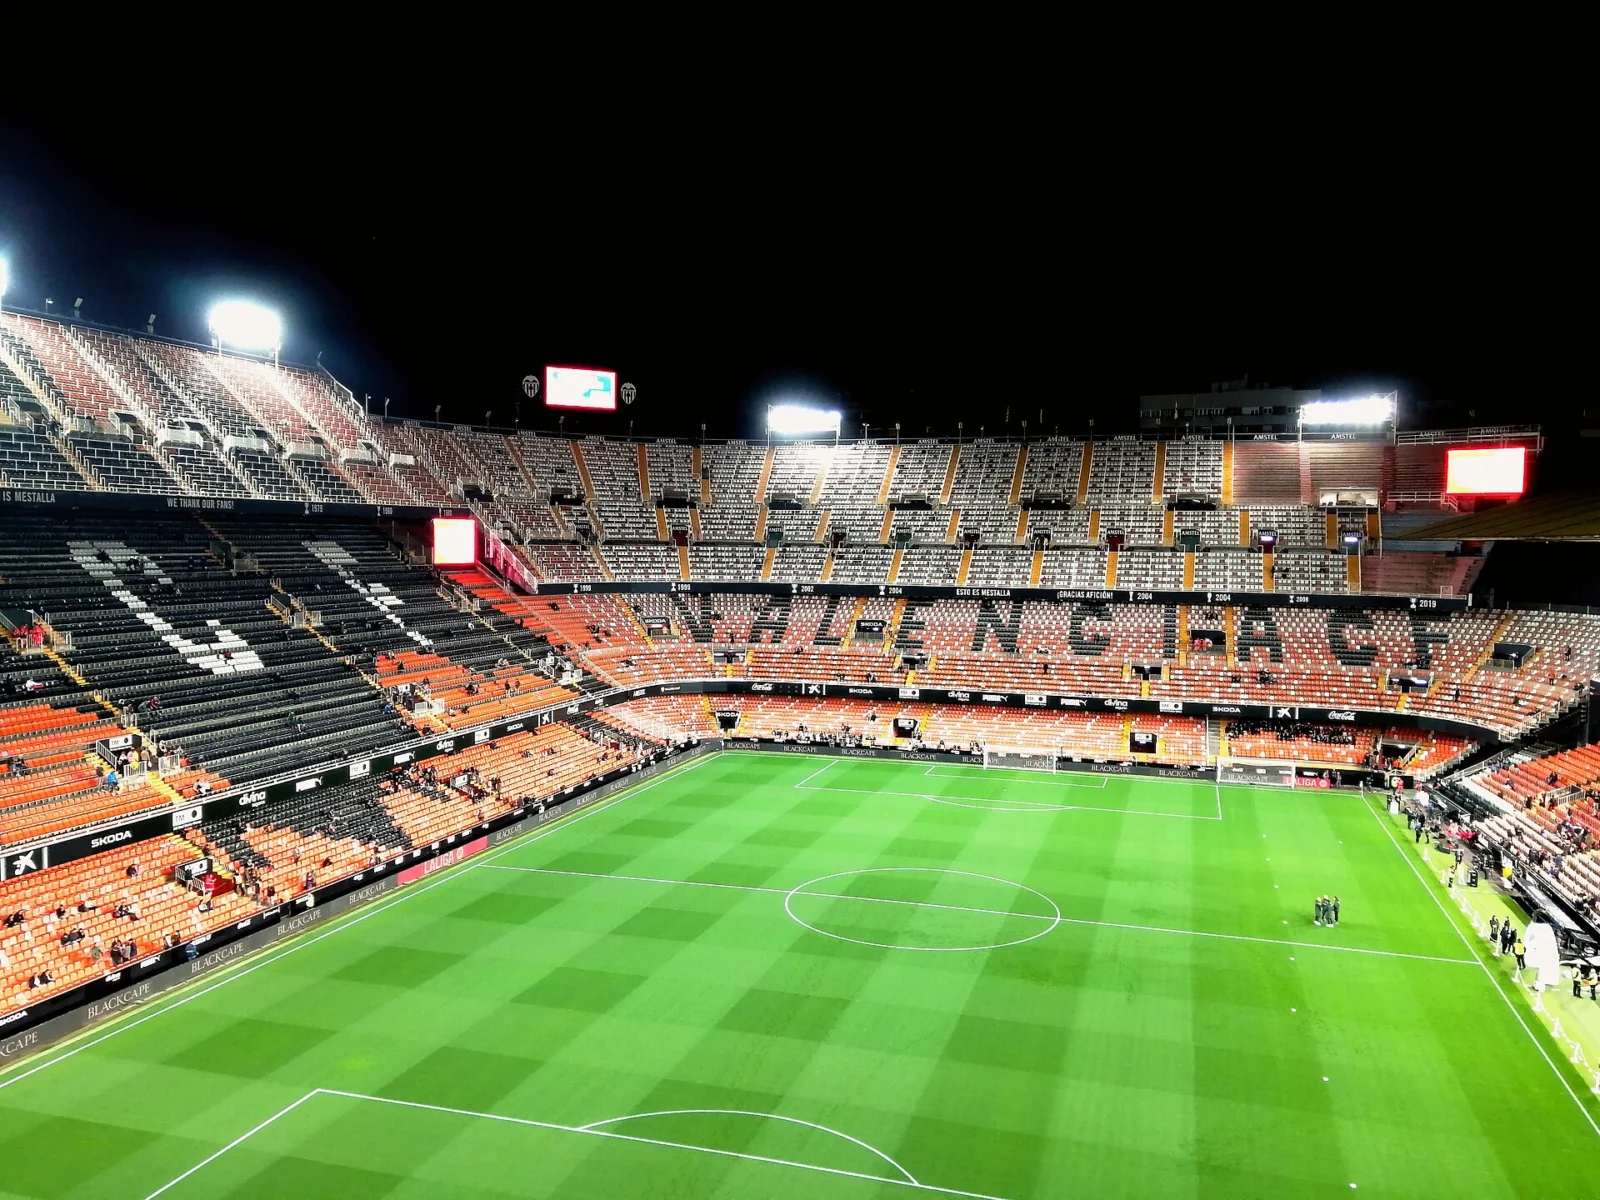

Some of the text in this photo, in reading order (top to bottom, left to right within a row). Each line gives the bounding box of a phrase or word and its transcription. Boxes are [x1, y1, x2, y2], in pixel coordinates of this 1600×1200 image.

[2, 491, 56, 503] IS MESTALLA
[167, 498, 234, 510] WE THANK OUR FANS!
[312, 504, 324, 512] 1979
[956, 588, 970, 596] ESTO
[1057, 590, 1085, 599] ¡GRACIAS
[1137, 592, 1152, 600] 2004
[1104, 698, 1128, 706] divina
[1328, 710, 1356, 721] Coca-Cola
[727, 742, 760, 750] BLACKCAPE
[842, 748, 876, 756] BLACKCAPE
[901, 752, 937, 760] BLACKCAPE
[962, 756, 1000, 764] BLACKAPE
[1092, 764, 1130, 773] BLACKCAPE
[1159, 770, 1199, 778] BLACKCAPE
[239, 792, 266, 806] divina
[92, 830, 132, 848] SKODA
[424, 852, 454, 874] LALIGA
[349, 882, 386, 905] BLACKCAPE
[278, 910, 321, 936] BLACKCAPE
[192, 942, 244, 973] BLACKCAPE
[88, 982, 150, 1020] BLACKCAPE
